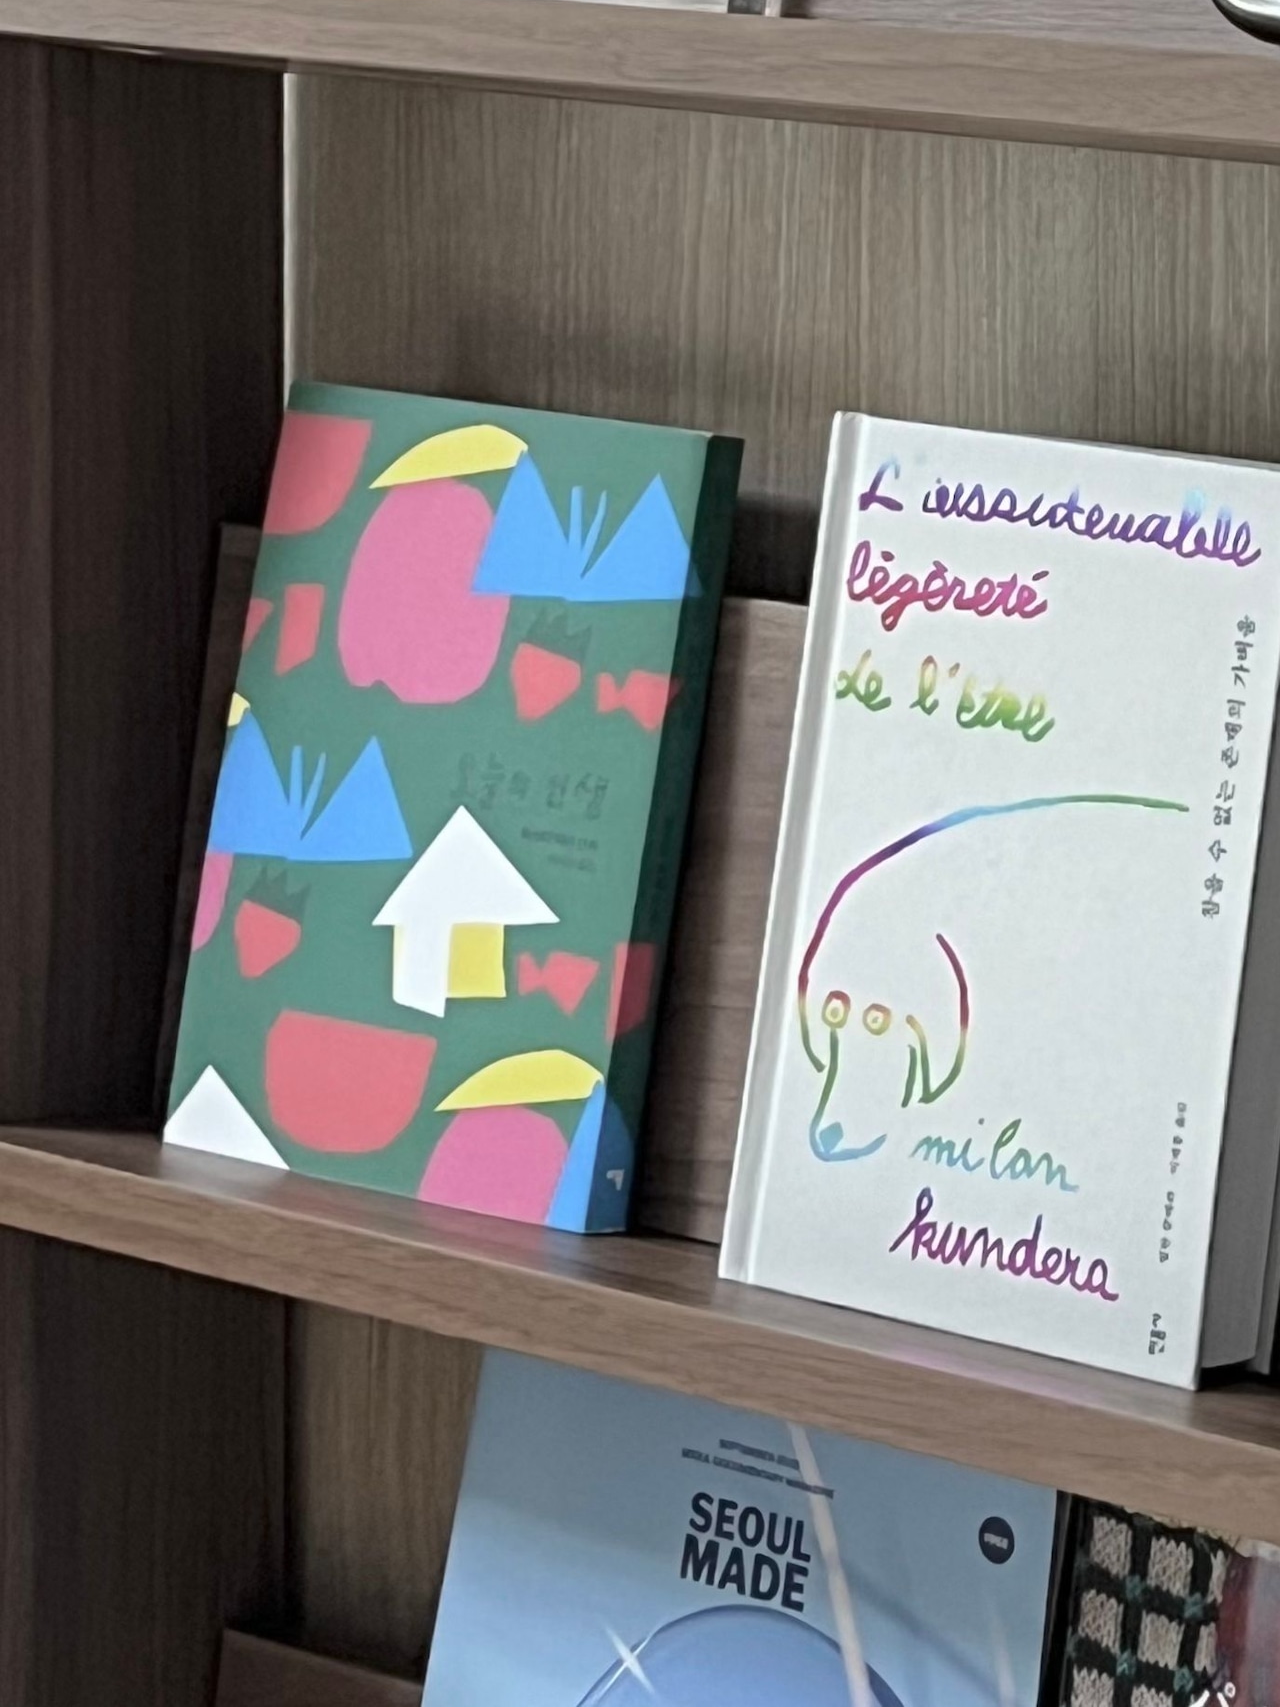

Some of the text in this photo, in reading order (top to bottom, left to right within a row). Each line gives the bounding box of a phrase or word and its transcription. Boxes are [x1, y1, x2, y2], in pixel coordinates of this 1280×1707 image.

[834, 650, 892, 711] de
[1208, 839, 1228, 862] 수
[909, 1117, 1080, 1193] milan
[889, 1187, 1120, 1302] kundera
[689, 1491, 812, 1564] SEOUL
[679, 1533, 809, 1613] MADE
